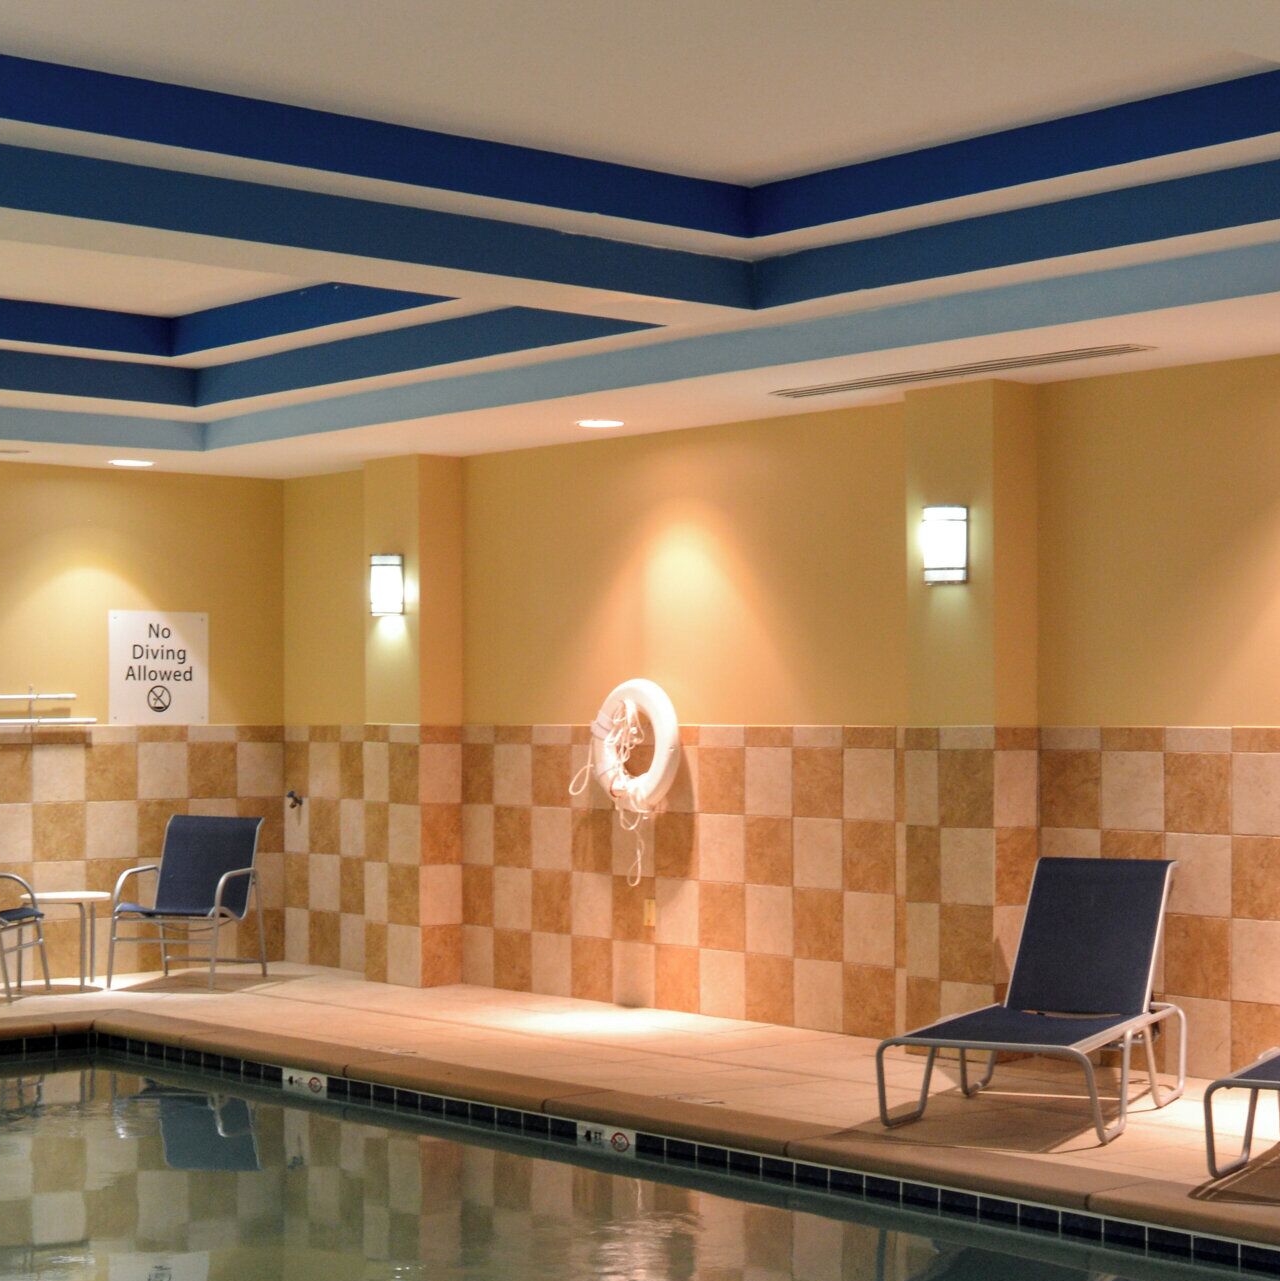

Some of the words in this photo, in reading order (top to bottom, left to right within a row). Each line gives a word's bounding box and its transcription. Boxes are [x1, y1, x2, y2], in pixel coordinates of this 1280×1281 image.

[148, 623, 171, 639] No
[132, 644, 187, 665] Diving
[125, 665, 193, 681] Allowed
